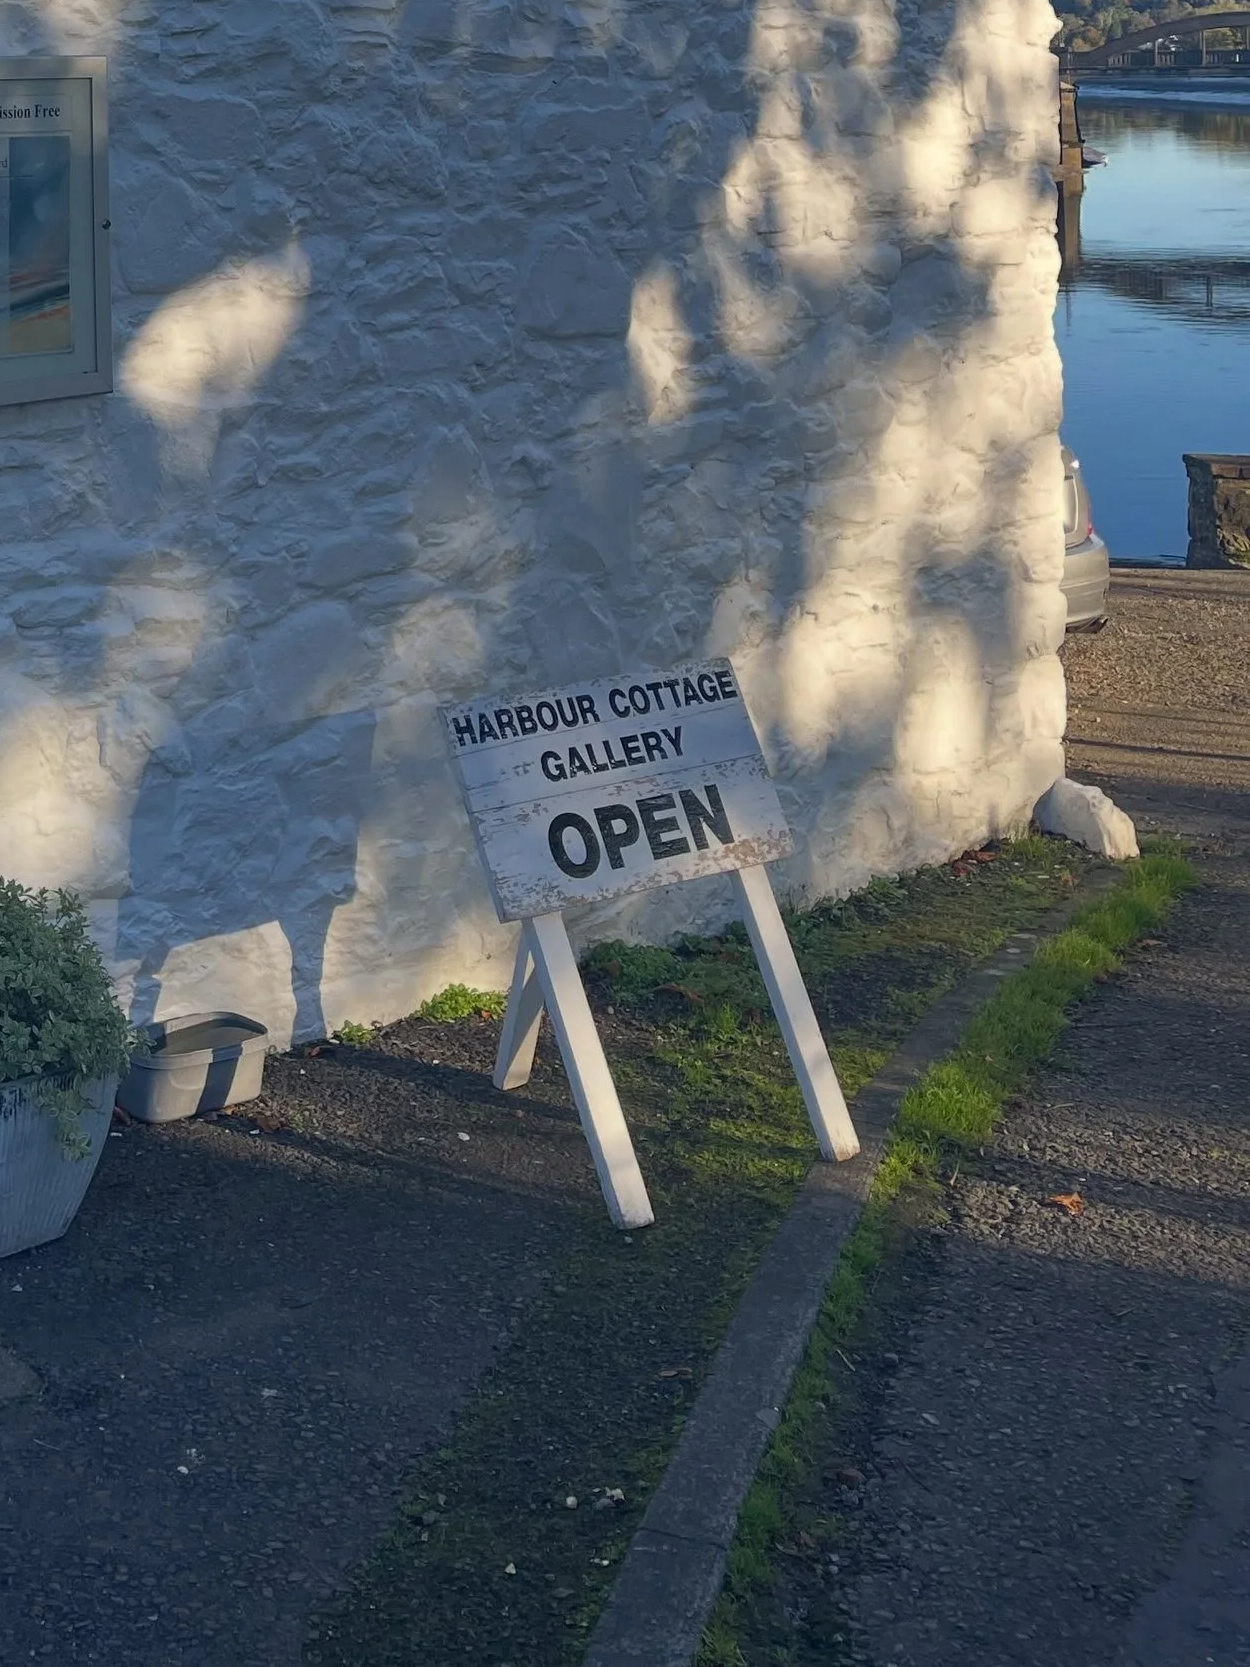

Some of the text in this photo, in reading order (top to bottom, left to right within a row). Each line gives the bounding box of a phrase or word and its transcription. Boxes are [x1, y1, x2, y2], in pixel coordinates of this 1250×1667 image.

[34, 103, 61, 118] Free
[451, 669, 739, 747] HARBOUR COTTAGE
[539, 725, 684, 783] GALLERY
[547, 783, 736, 880] OPEN
